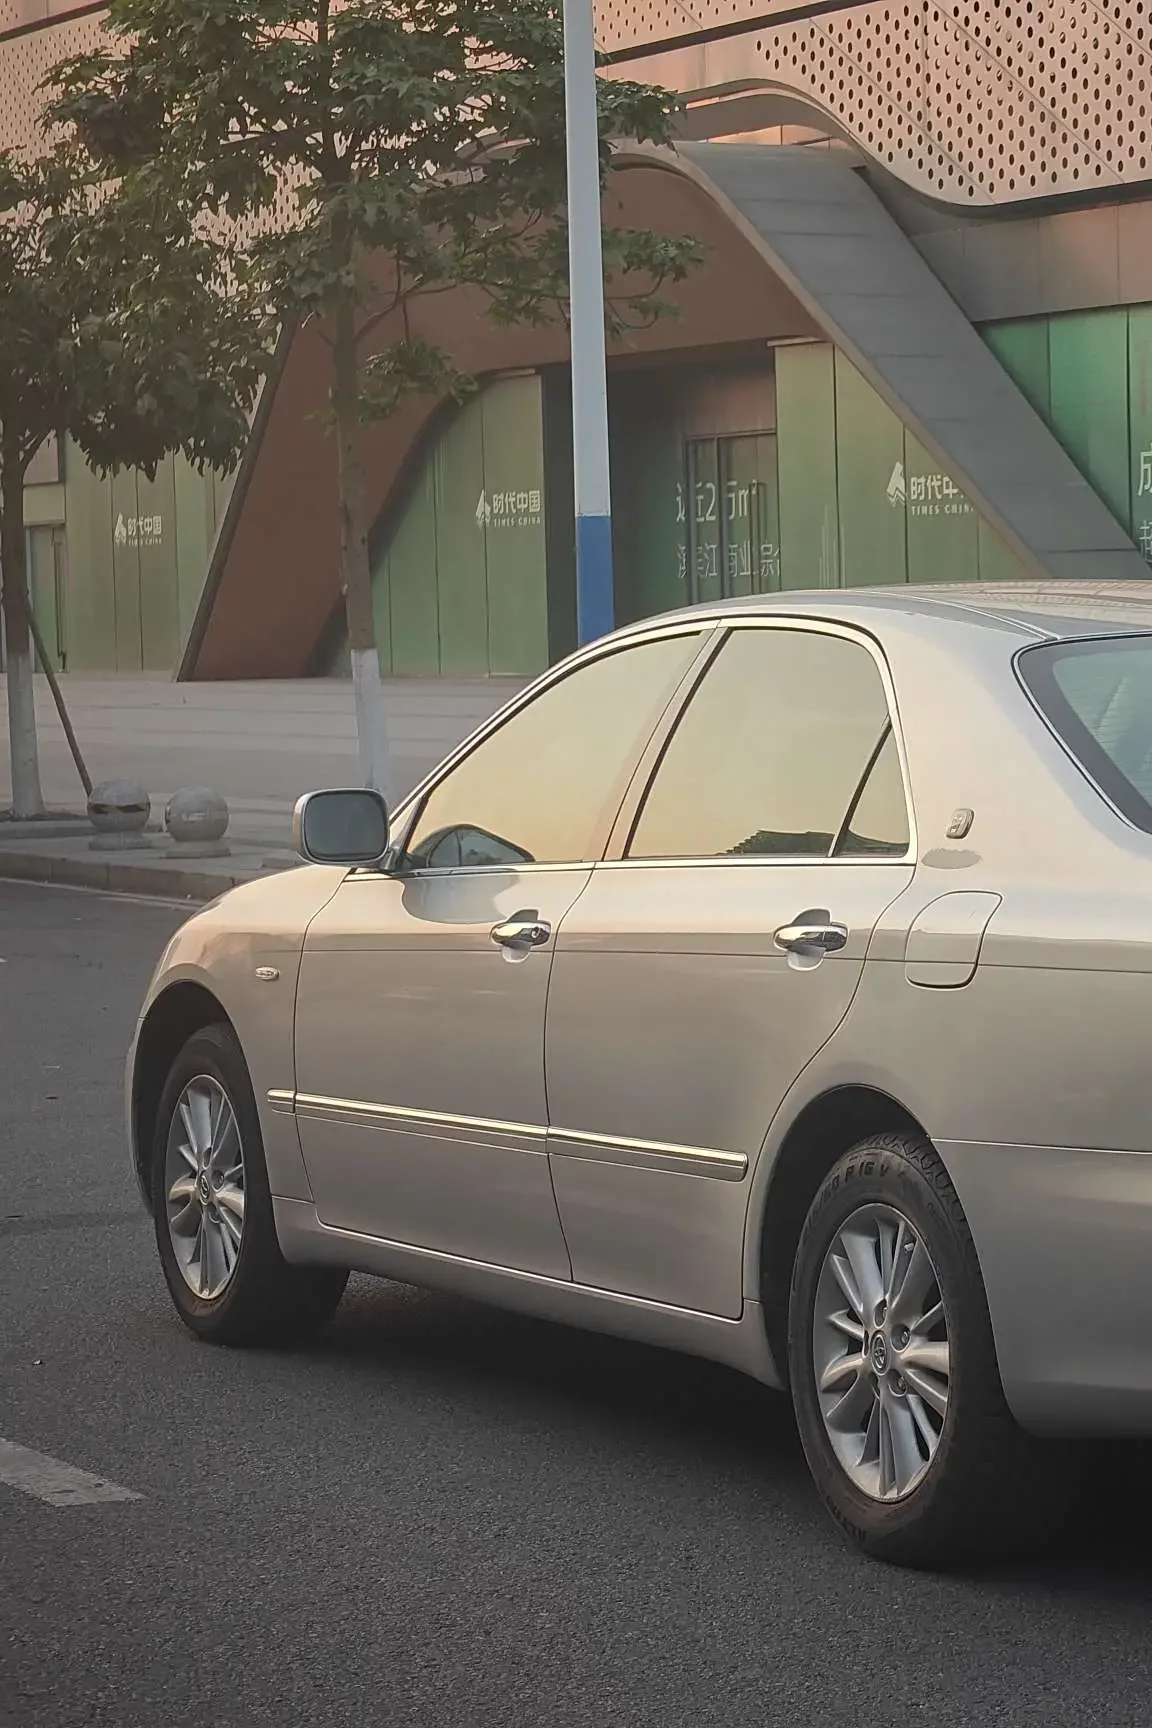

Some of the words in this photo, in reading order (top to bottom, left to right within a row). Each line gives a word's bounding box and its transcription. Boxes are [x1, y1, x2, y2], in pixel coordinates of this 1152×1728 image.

[910, 474, 964, 501] 时代中
[492, 489, 541, 514] 时代中国
[911, 504, 941, 516] TIMES
[944, 503, 974, 514] CHIN
